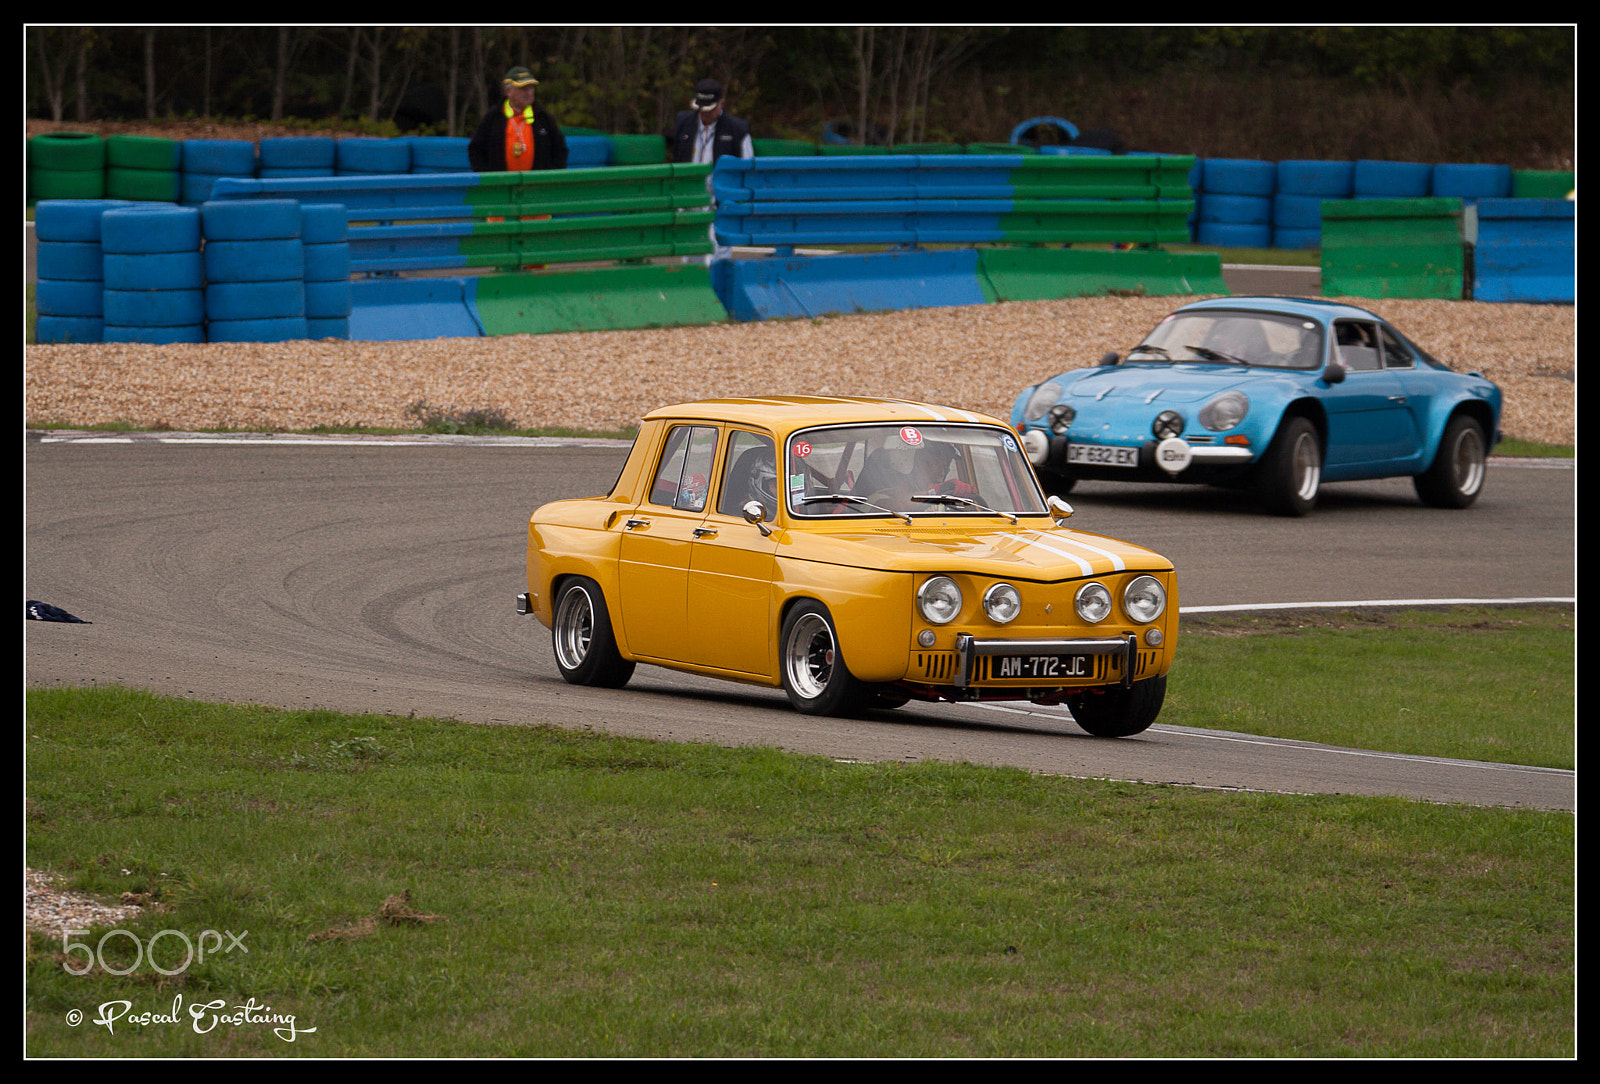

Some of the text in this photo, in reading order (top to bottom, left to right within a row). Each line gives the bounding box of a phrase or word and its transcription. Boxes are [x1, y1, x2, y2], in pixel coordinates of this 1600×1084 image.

[904, 428, 918, 439] B
[796, 444, 811, 454] 16
[1000, 656, 1086, 676] AM-772-JC
